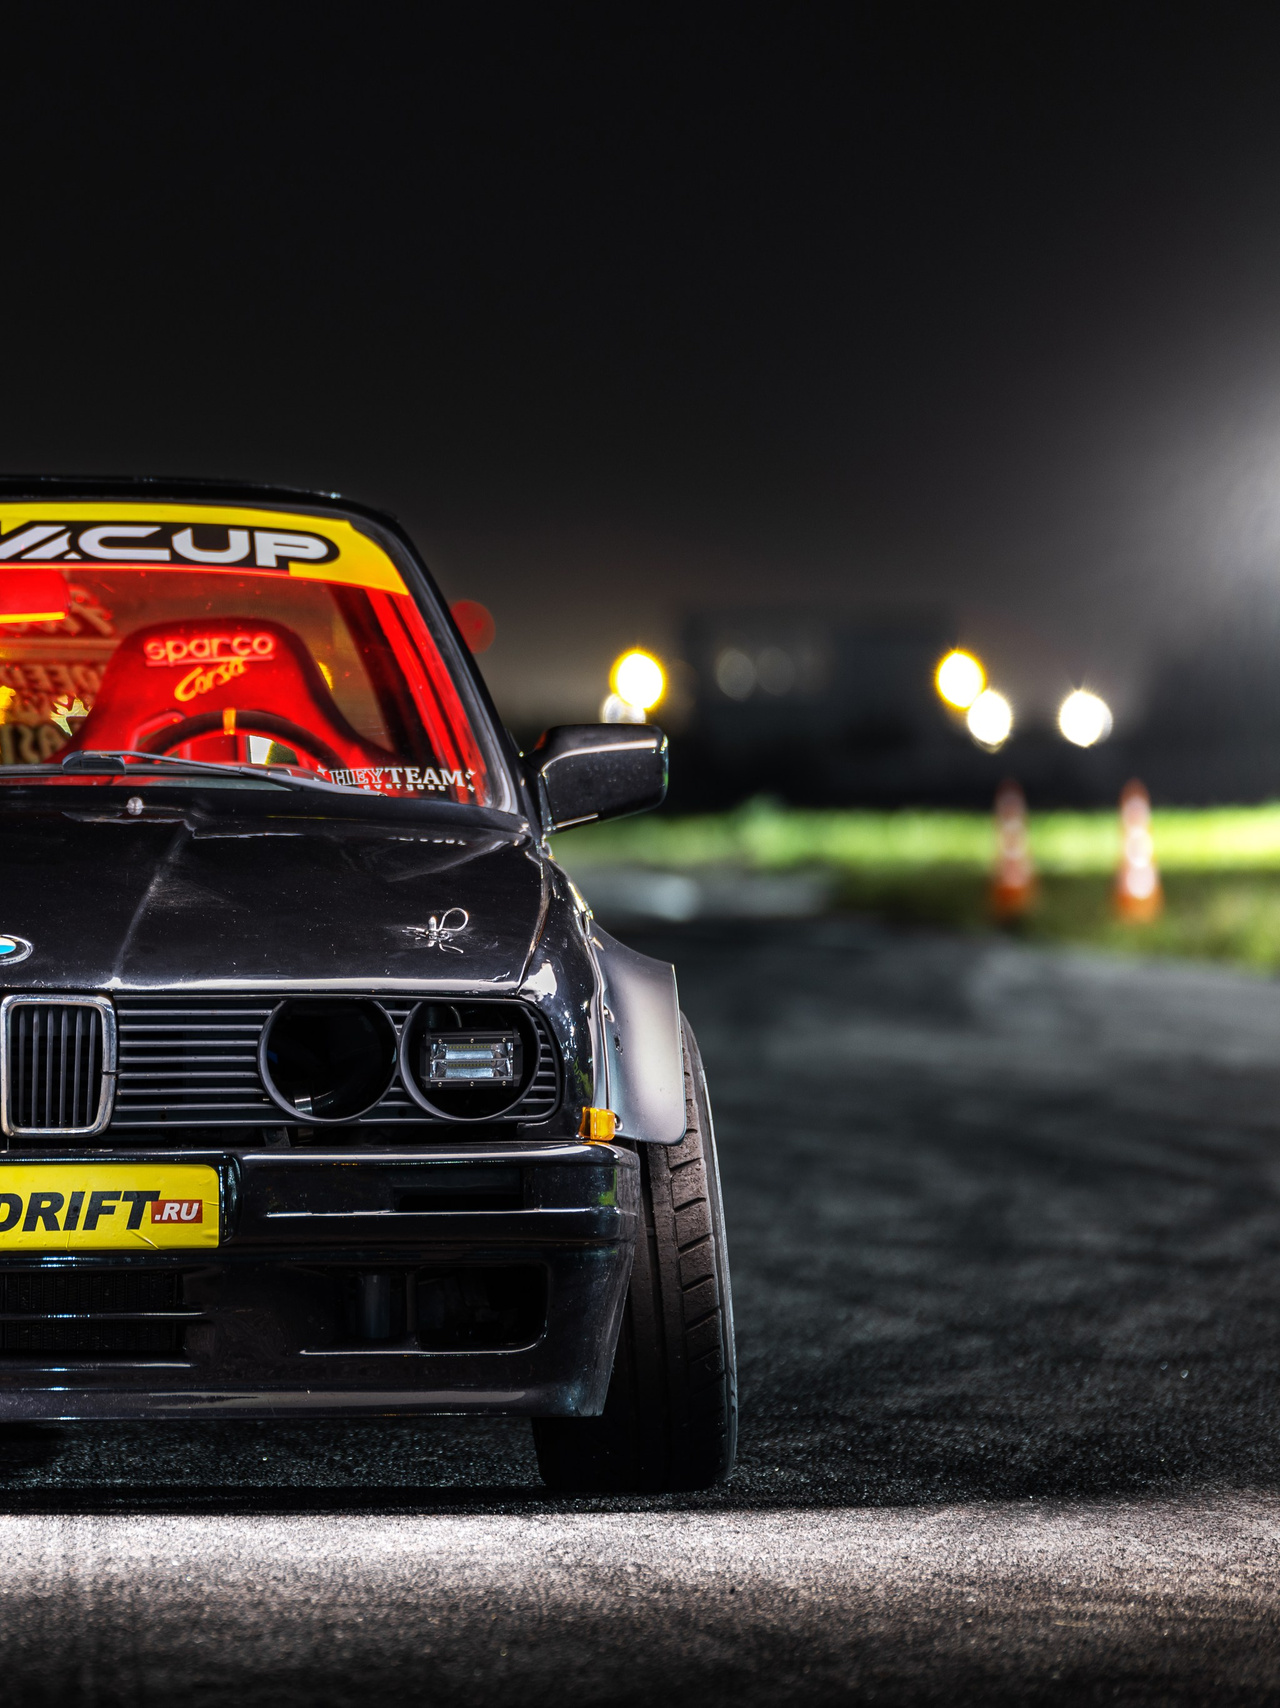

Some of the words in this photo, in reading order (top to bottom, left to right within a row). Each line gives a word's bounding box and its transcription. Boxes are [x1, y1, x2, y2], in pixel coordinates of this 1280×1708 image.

[77, 525, 329, 567] CUP
[146, 634, 274, 662] sparco
[174, 658, 247, 701] Corsa
[363, 784, 447, 792] everyone
